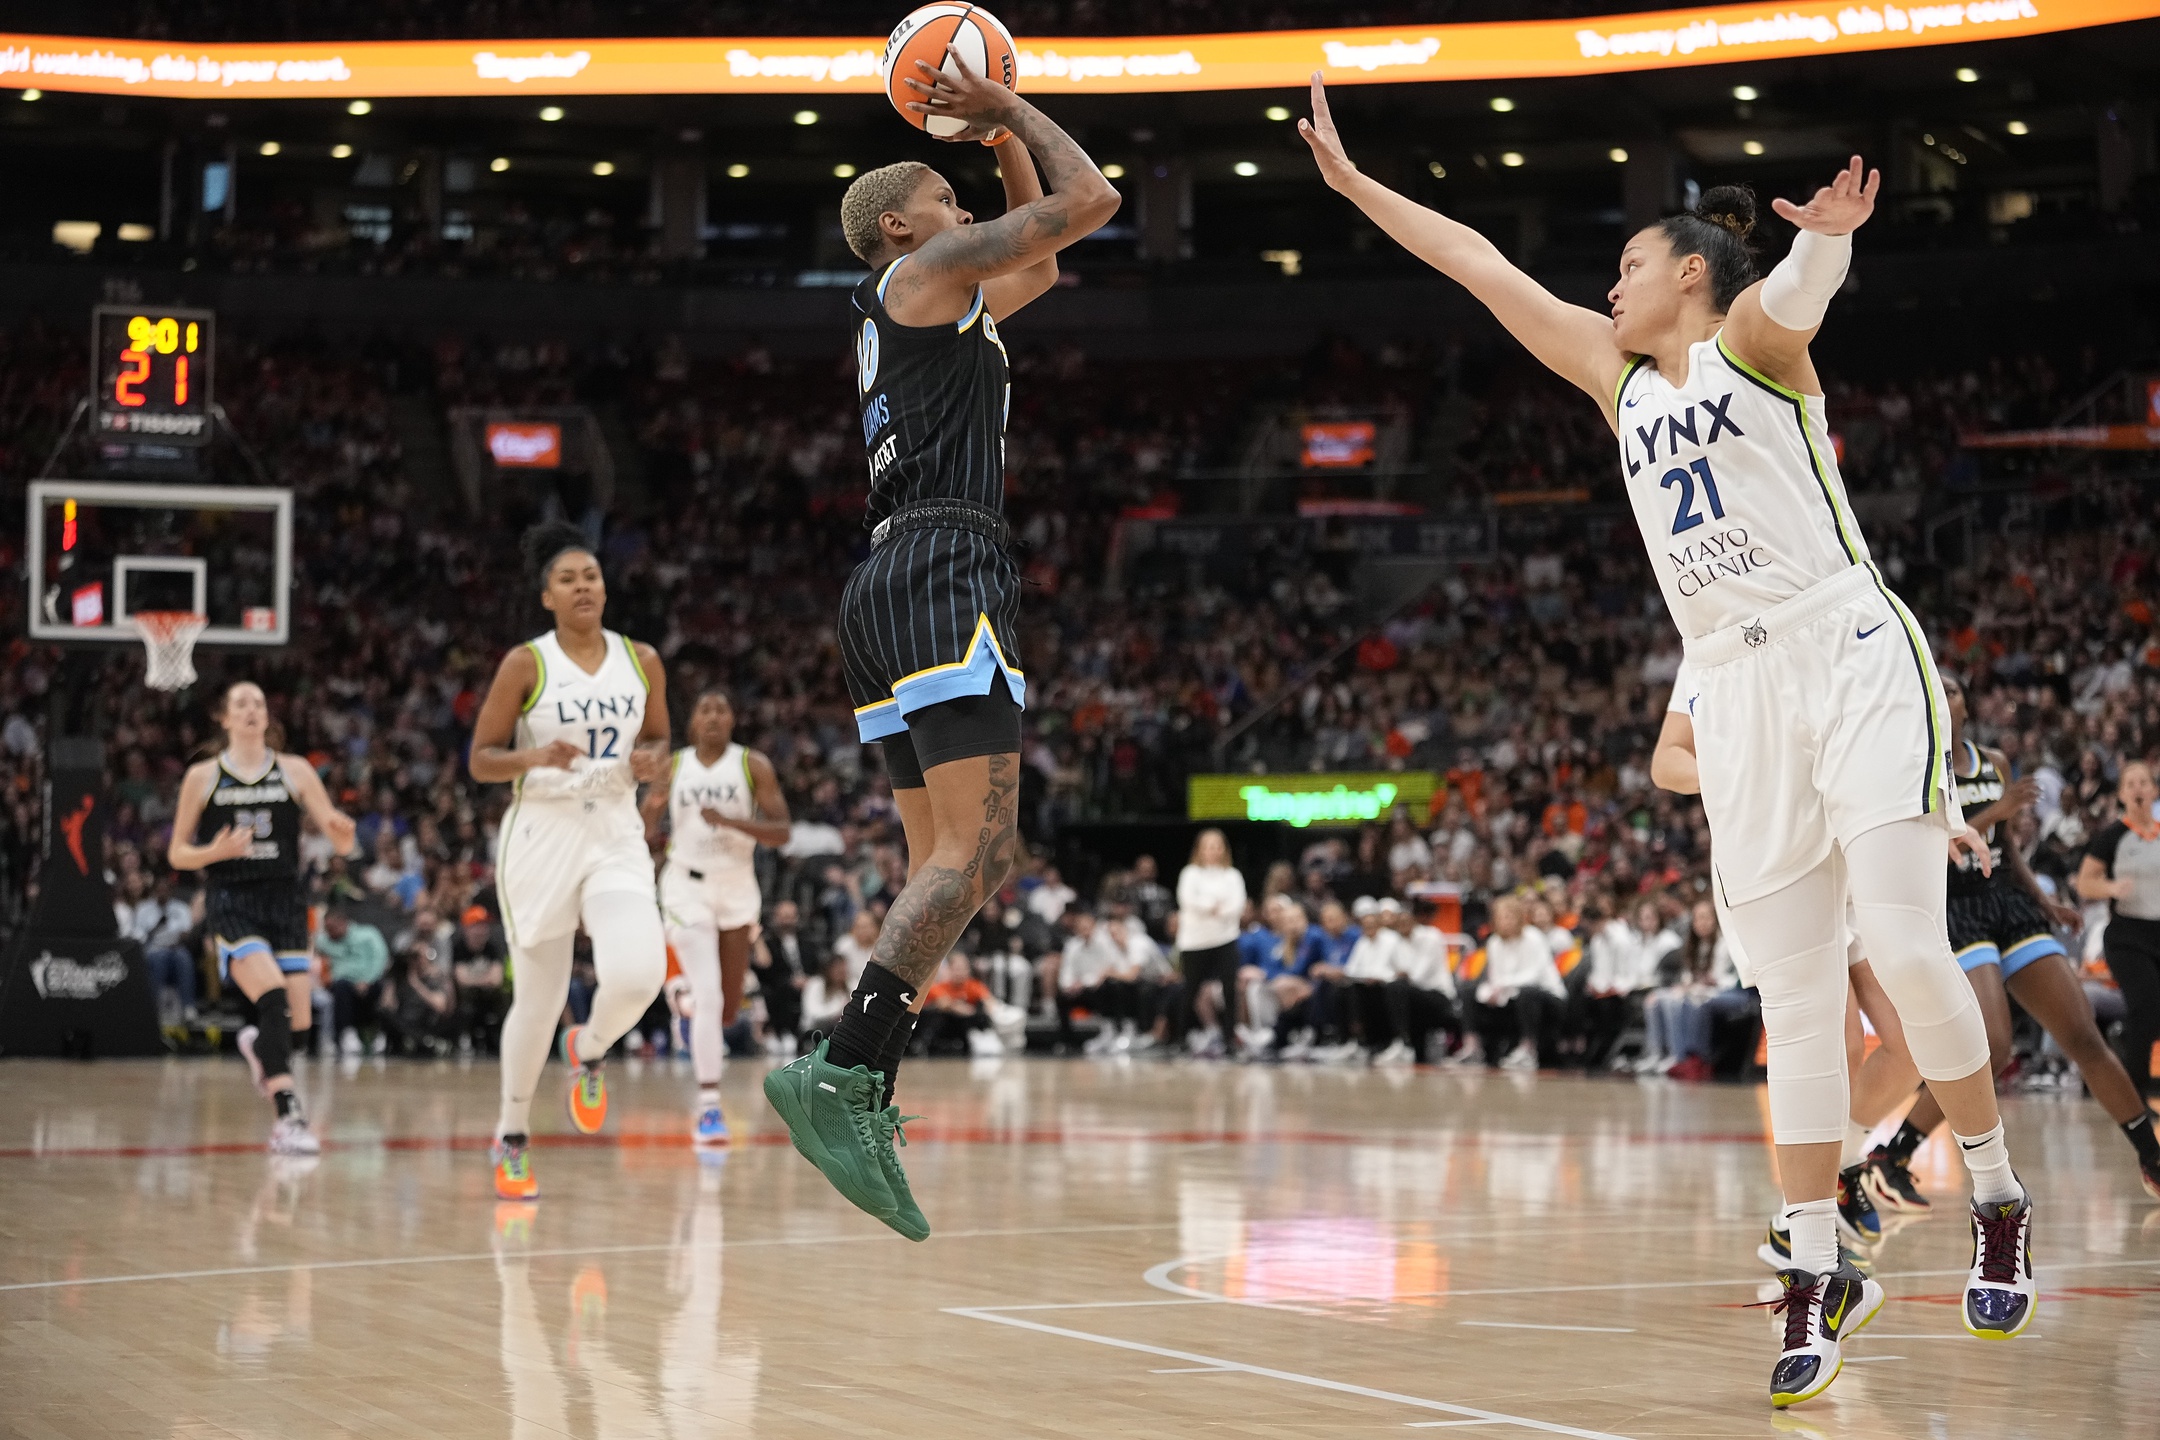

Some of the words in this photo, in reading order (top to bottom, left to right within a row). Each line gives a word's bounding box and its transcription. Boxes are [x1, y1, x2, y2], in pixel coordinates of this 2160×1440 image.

[1575, 30, 1608, 57] To
[1608, 30, 1675, 56] every
[1676, 19, 1718, 54] girl
[1838, 6, 1884, 35] this
[1884, 4, 1908, 31] is
[1908, 4, 1965, 34] your
[0, 47, 29, 74] irl
[151, 54, 196, 81] this
[222, 61, 277, 86] your
[726, 50, 759, 77] To
[759, 56, 831, 81] every
[829, 51, 874, 81] girl
[1068, 56, 1125, 81] your
[128, 316, 198, 354] 9:01
[116, 349, 188, 407] 21
[874, 434, 897, 477] AT&T
[1625, 392, 1745, 478] LYNX
[1660, 456, 1725, 535] 21
[1667, 528, 1748, 573] MAYO
[1677, 547, 1772, 597] CLINIC
[558, 696, 638, 724] LYNX
[587, 727, 618, 758] 12
[679, 785, 740, 808] LYNX
